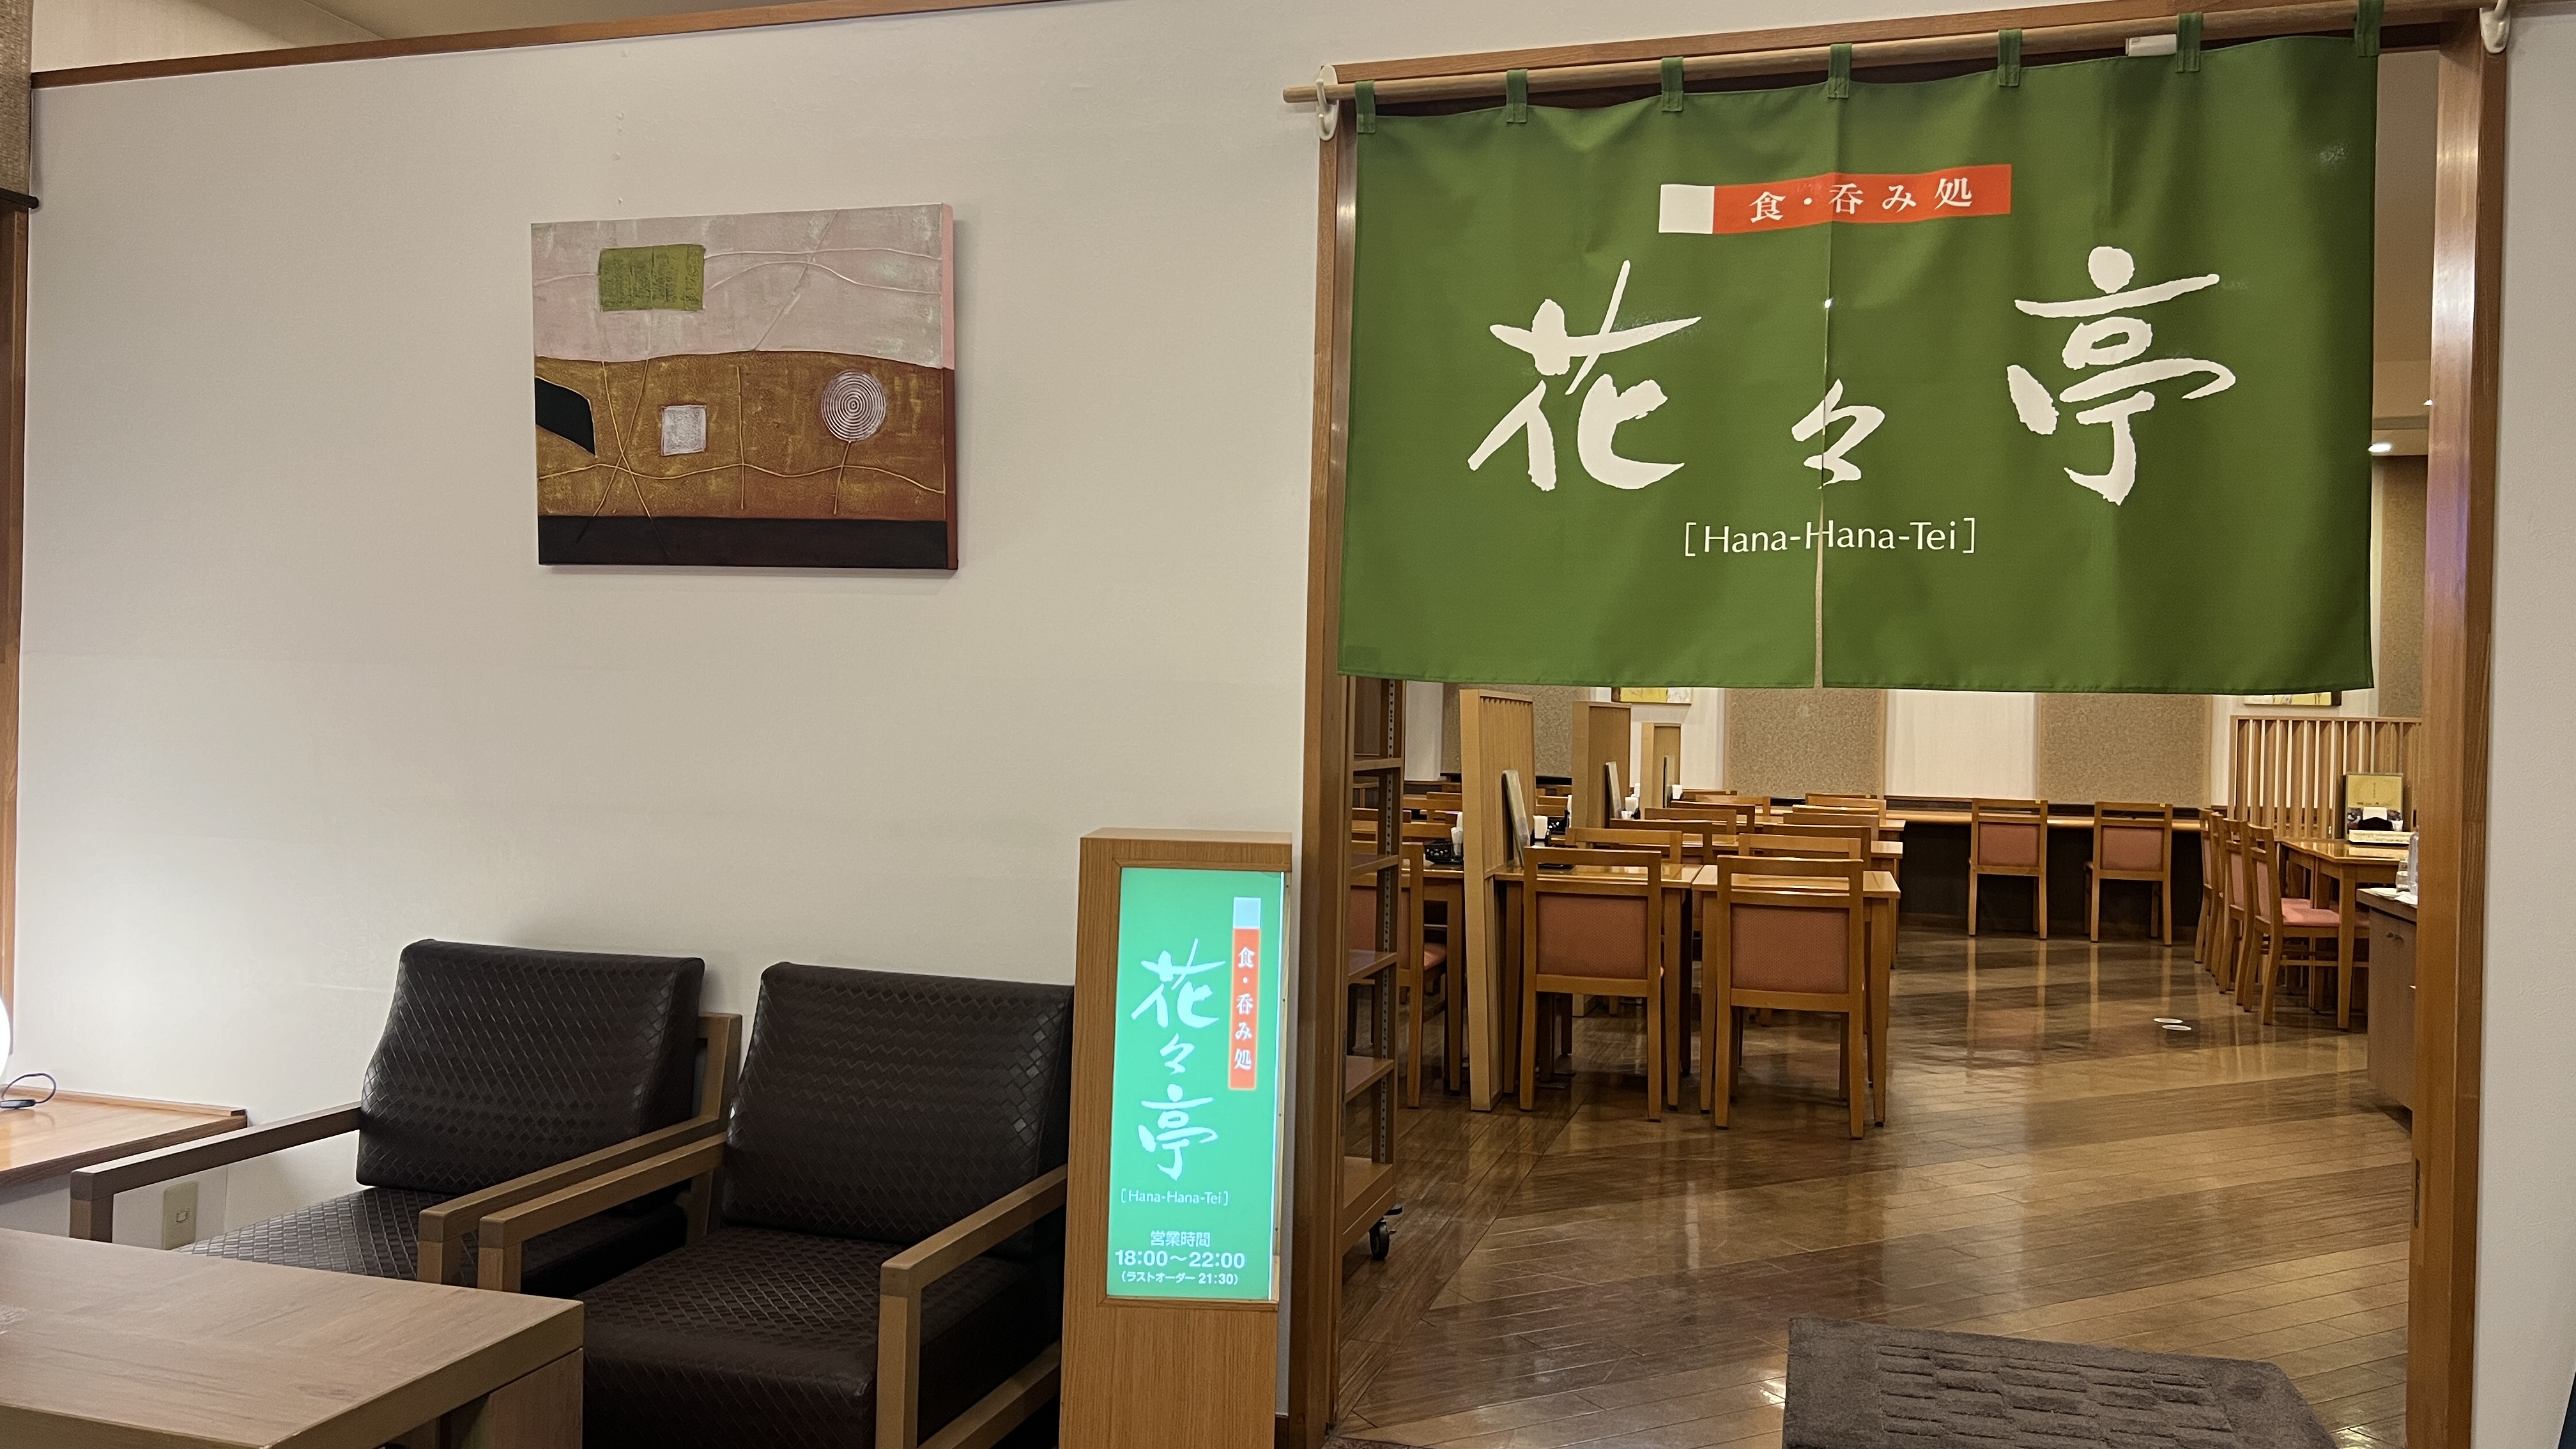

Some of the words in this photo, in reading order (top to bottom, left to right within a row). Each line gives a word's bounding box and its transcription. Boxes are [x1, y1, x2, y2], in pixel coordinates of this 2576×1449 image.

[1749, 176, 1973, 223] 食・呑み処
[1467, 245, 2237, 507] 花々亭
[1684, 517, 1977, 556] [Hana-Hana-Tei]
[1233, 946, 1255, 1071] 食・呑み処
[1131, 938, 1225, 1181] 花々亭
[1121, 1188, 1229, 1206] [Hana-Hana-Tei]
[1150, 1230, 1211, 1248] 営業時間
